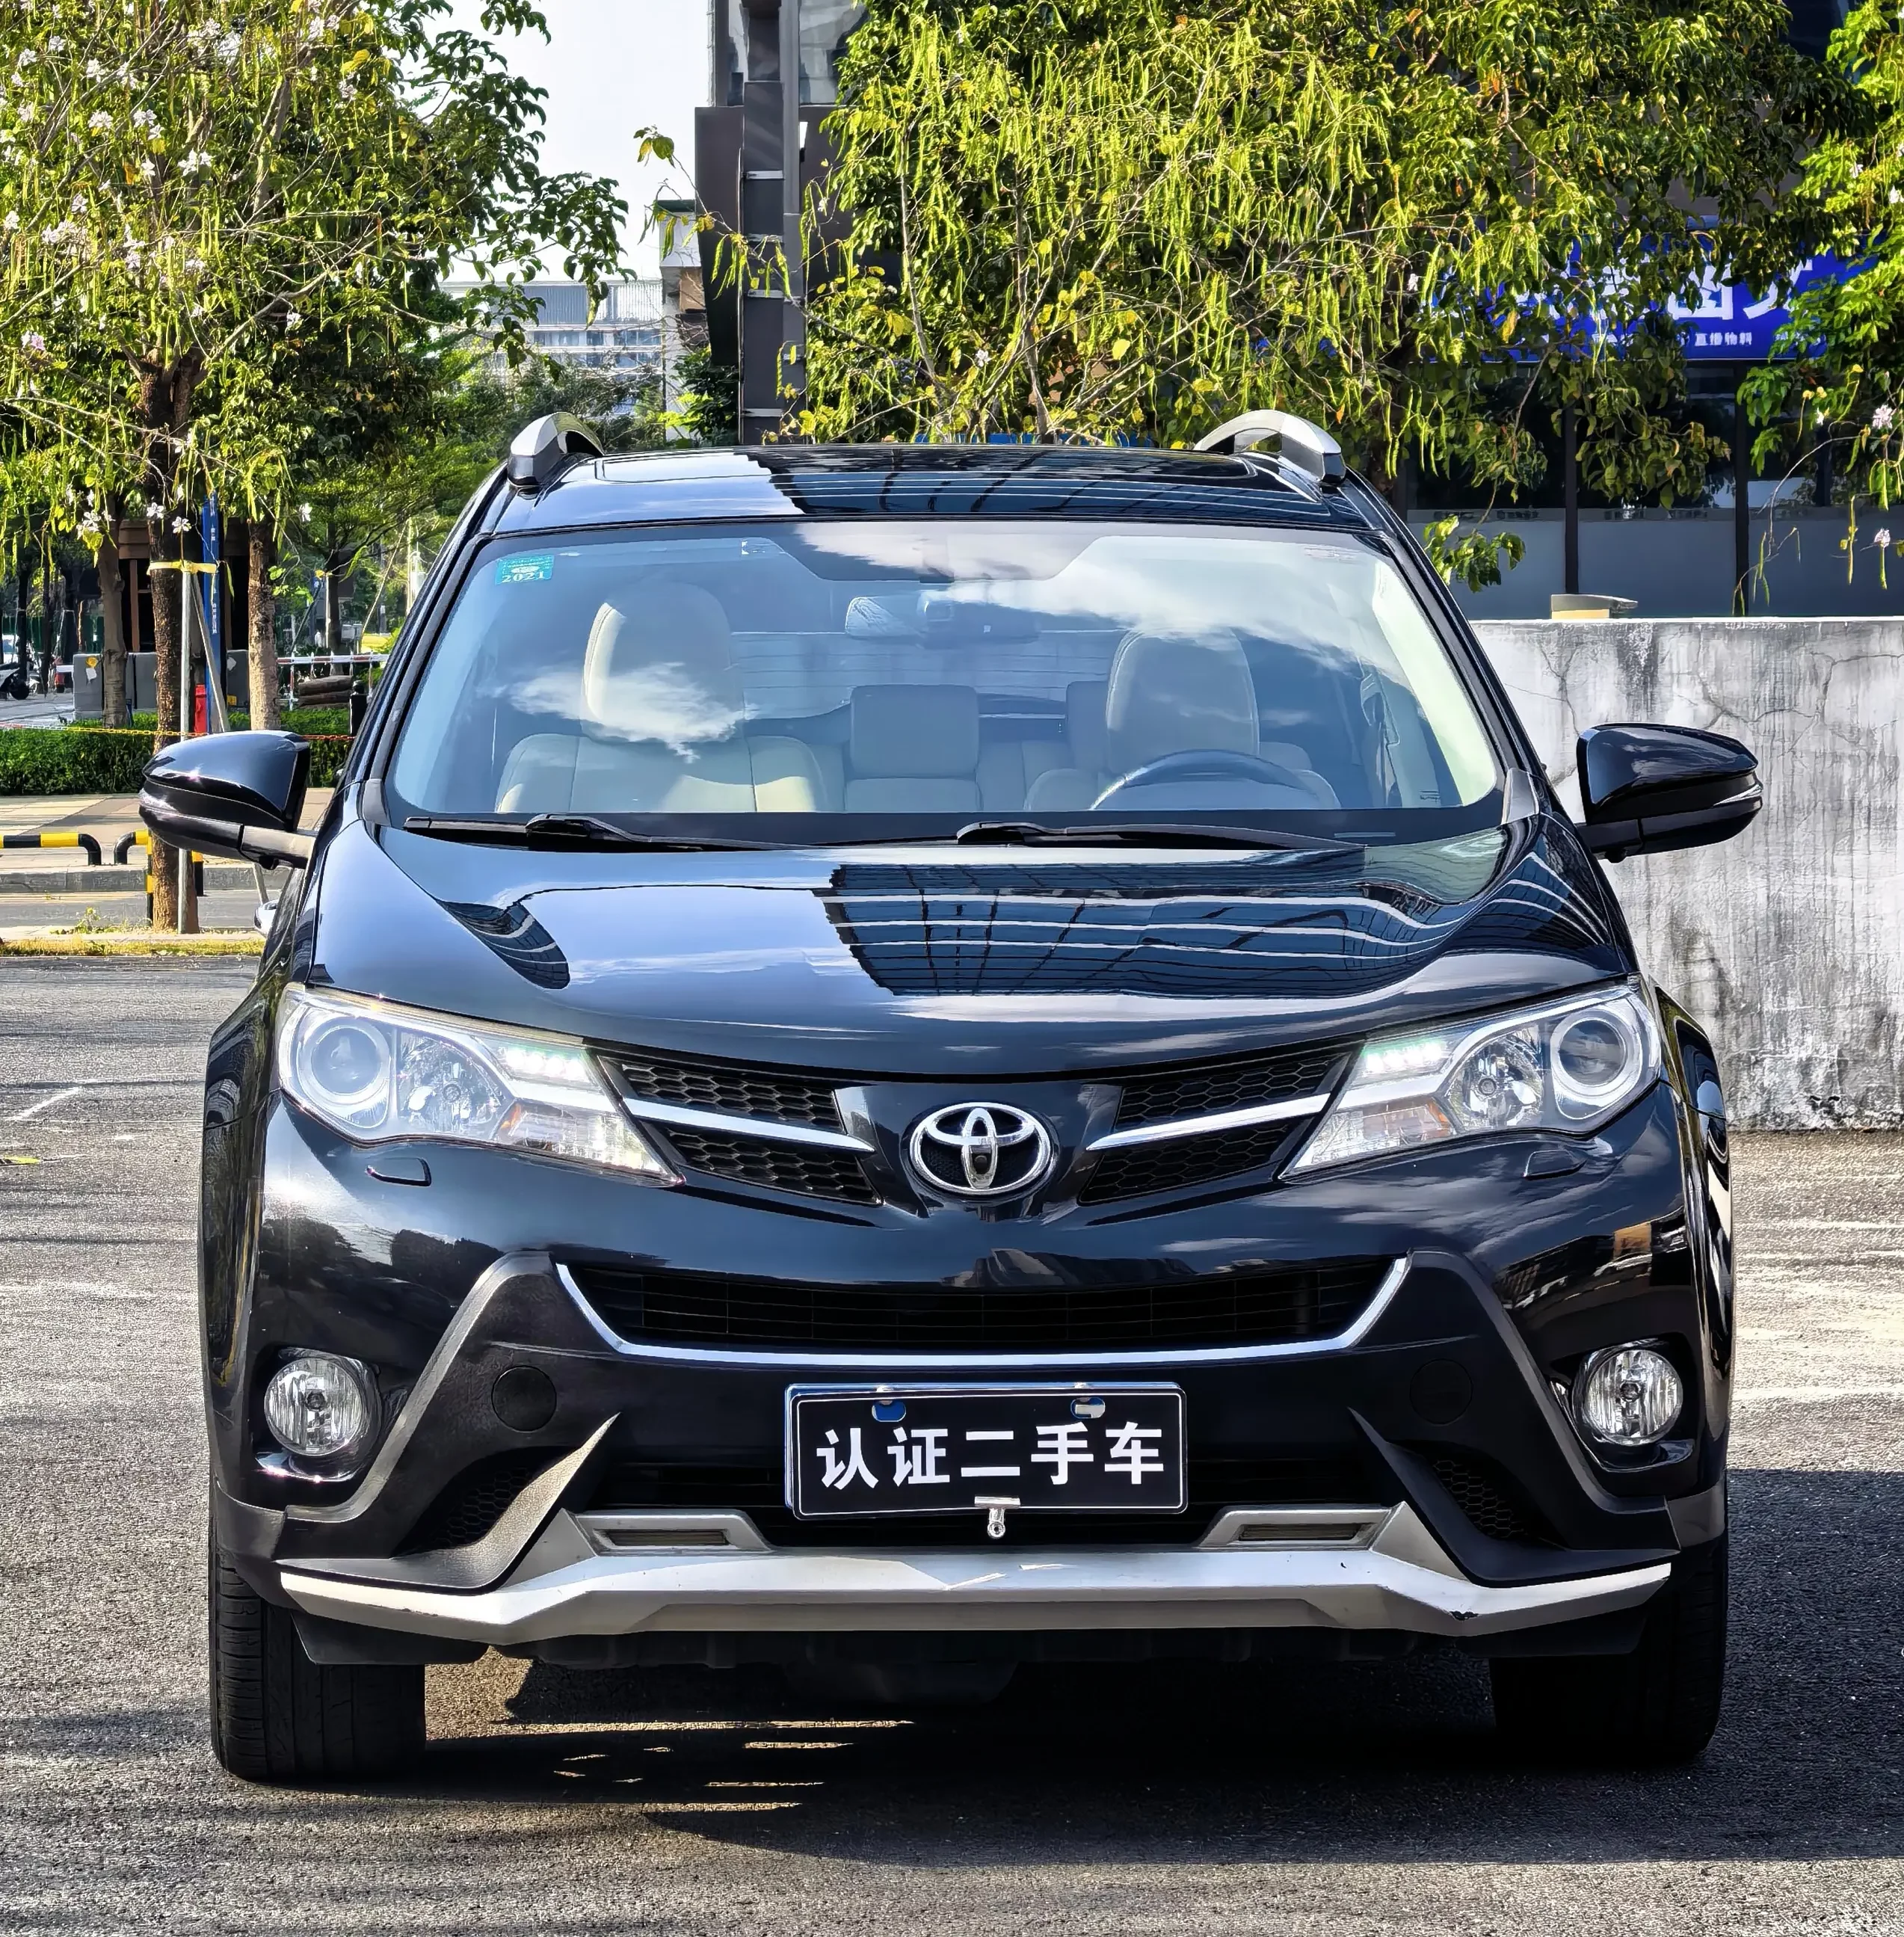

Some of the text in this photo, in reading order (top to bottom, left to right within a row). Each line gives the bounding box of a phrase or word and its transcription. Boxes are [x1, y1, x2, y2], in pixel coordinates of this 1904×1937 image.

[502, 570, 545, 583] 2021
[816, 1421, 1165, 1490] 认证二手车
